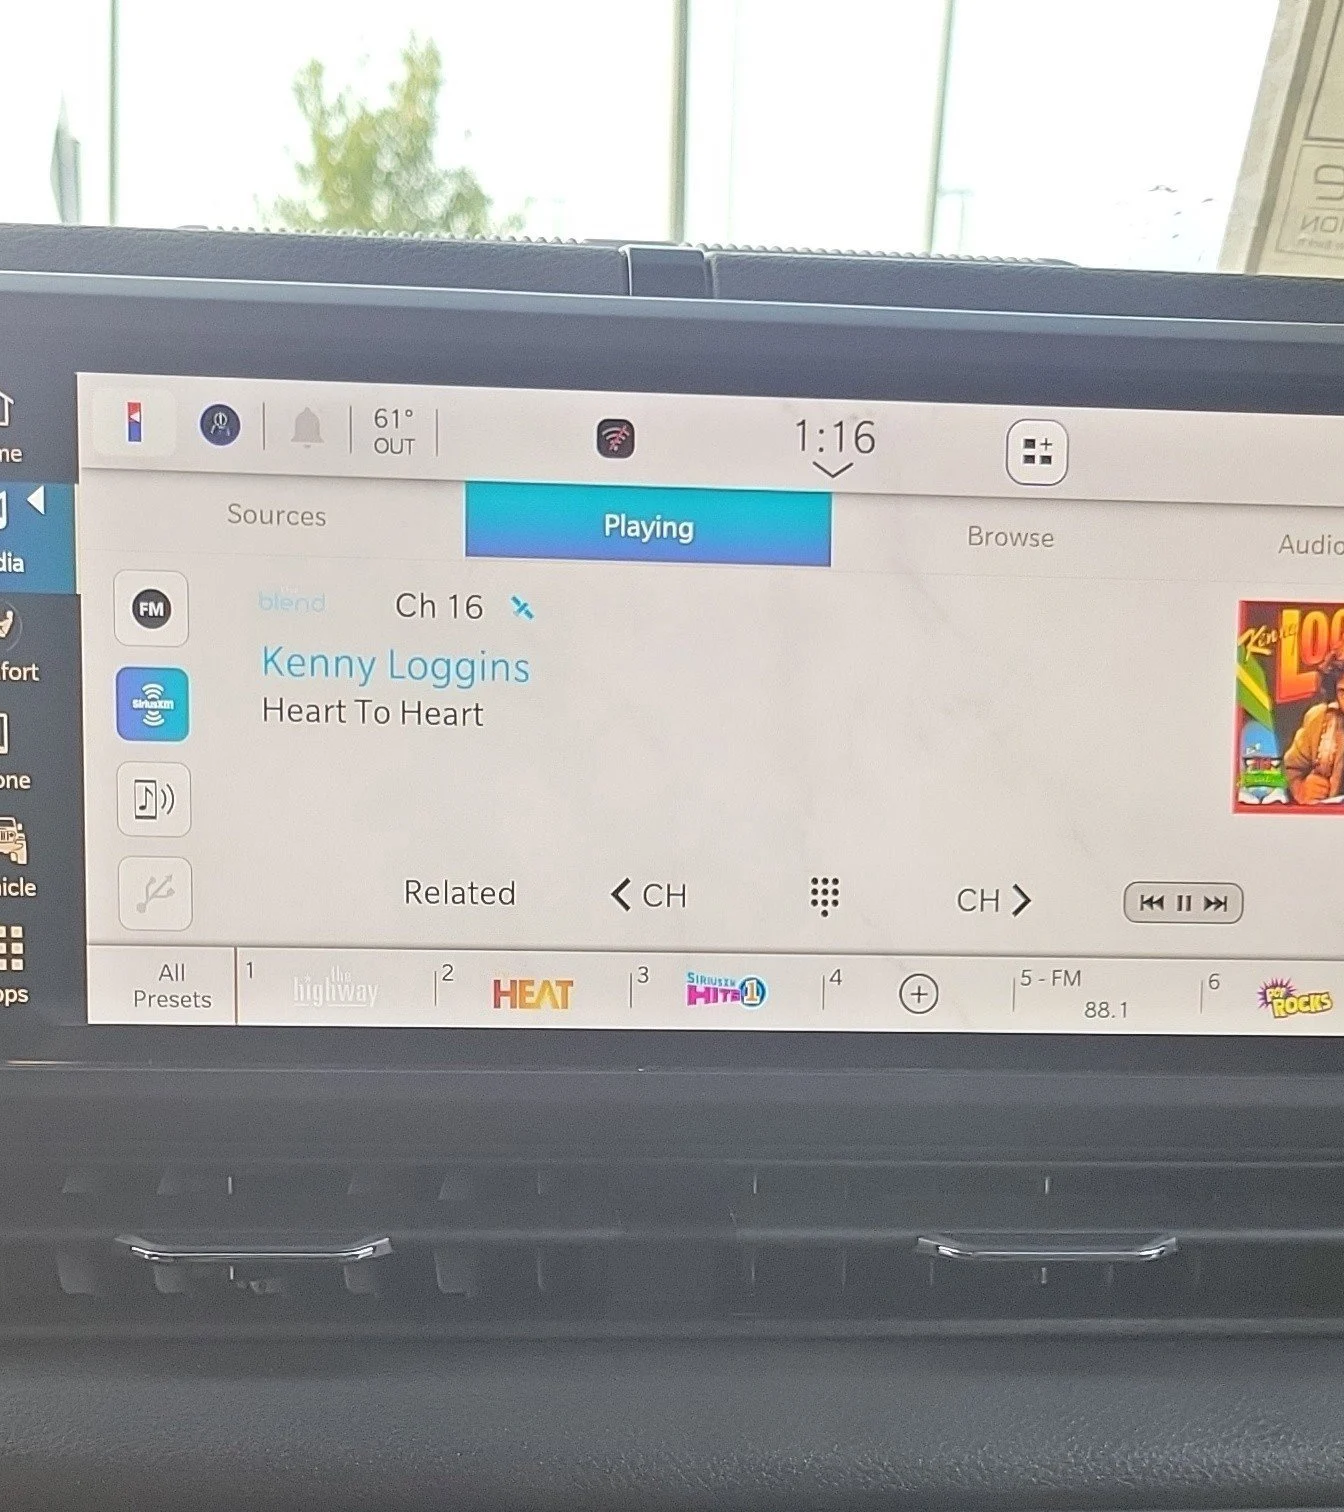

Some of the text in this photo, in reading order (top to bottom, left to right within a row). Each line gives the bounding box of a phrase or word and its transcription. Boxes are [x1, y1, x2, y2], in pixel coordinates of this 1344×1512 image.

[373, 407, 414, 430] 61°
[373, 437, 416, 457] OUT
[794, 419, 878, 457] 1:16
[226, 502, 327, 529] Sources
[604, 512, 696, 546] Playing
[967, 522, 1055, 550] Browse
[139, 602, 164, 617] FM
[258, 590, 327, 613] blend
[396, 592, 484, 620] Ch 16
[262, 645, 530, 689] Kenny Loggins
[263, 697, 484, 727] Heart To Heart
[404, 879, 517, 907] Related
[642, 884, 688, 909] CH
[957, 888, 1001, 914] CH
[158, 963, 185, 982] All
[246, 961, 254, 979] 1
[441, 964, 455, 982] 2
[636, 966, 649, 984] 3
[829, 968, 843, 987] 4
[1020, 969, 1032, 987] 5
[1051, 969, 1082, 987] FM
[1208, 973, 1220, 990] 6
[134, 989, 212, 1008] Presets
[293, 975, 379, 1007] highway
[493, 979, 574, 1009] HEAT
[1084, 1001, 1127, 1019] 88.1
[1272, 991, 1333, 1018] ROCKS
